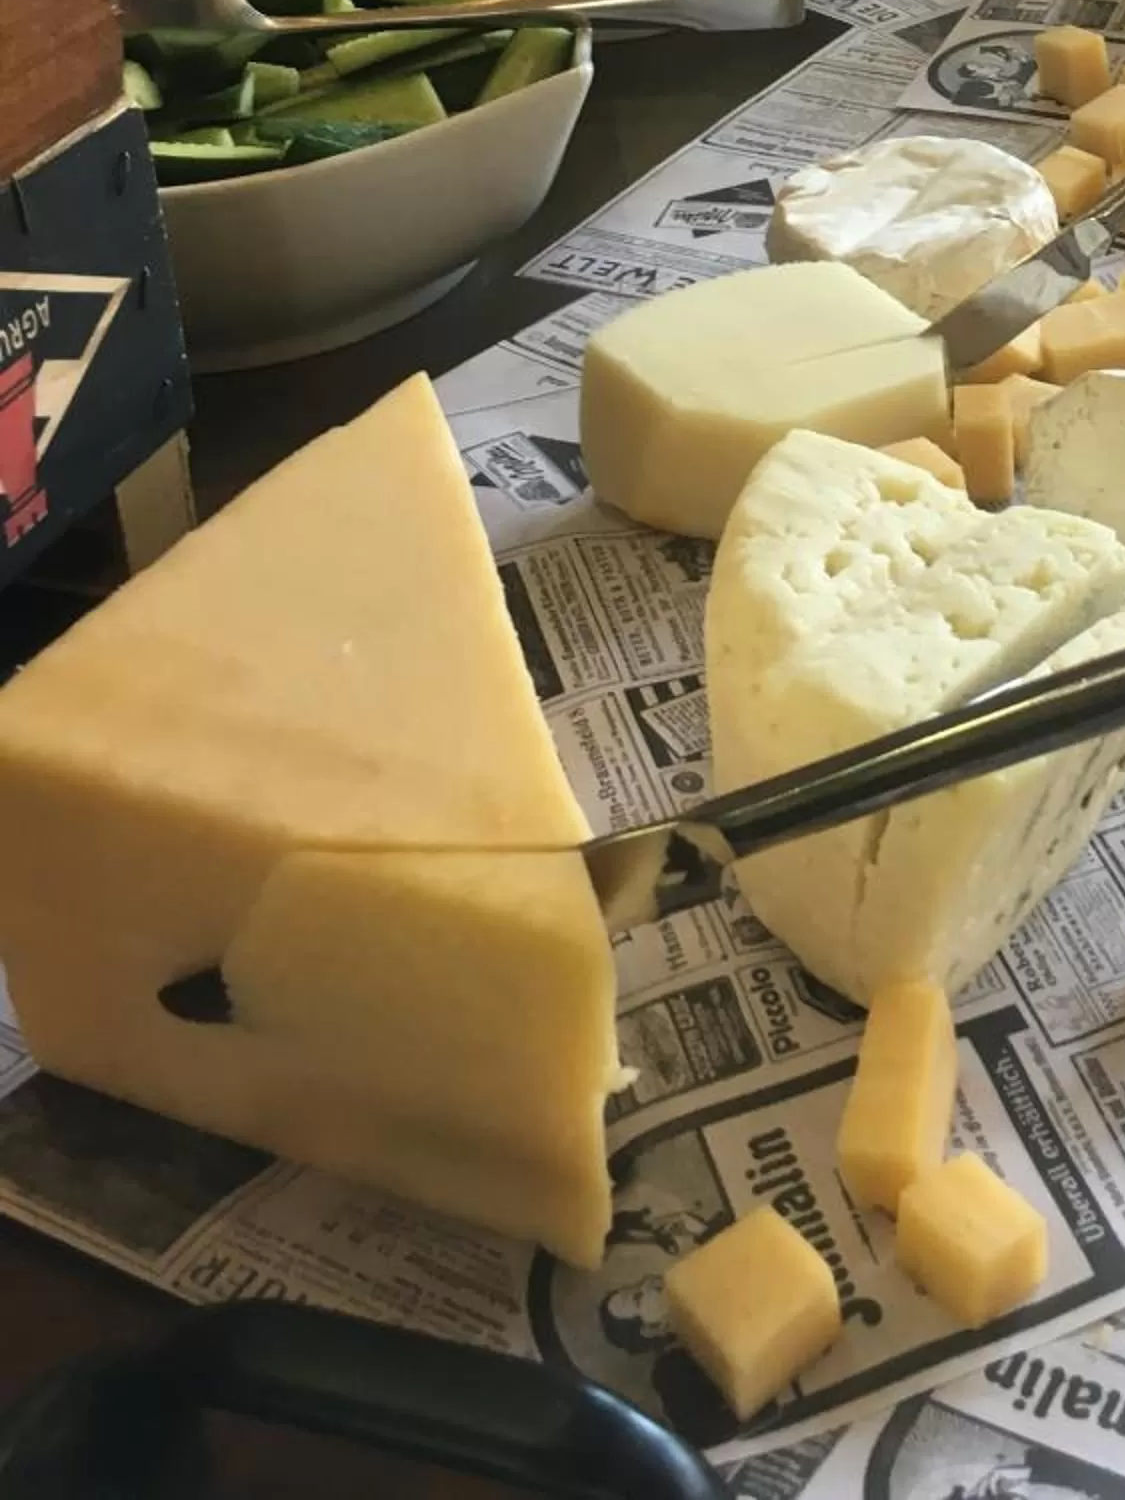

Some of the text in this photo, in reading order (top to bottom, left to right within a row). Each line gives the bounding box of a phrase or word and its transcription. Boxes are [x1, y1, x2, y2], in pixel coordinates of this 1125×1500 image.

[547, 253, 657, 289] WELT
[998, 932, 1048, 996] Rober
[1043, 1158, 1108, 1248] Überall
